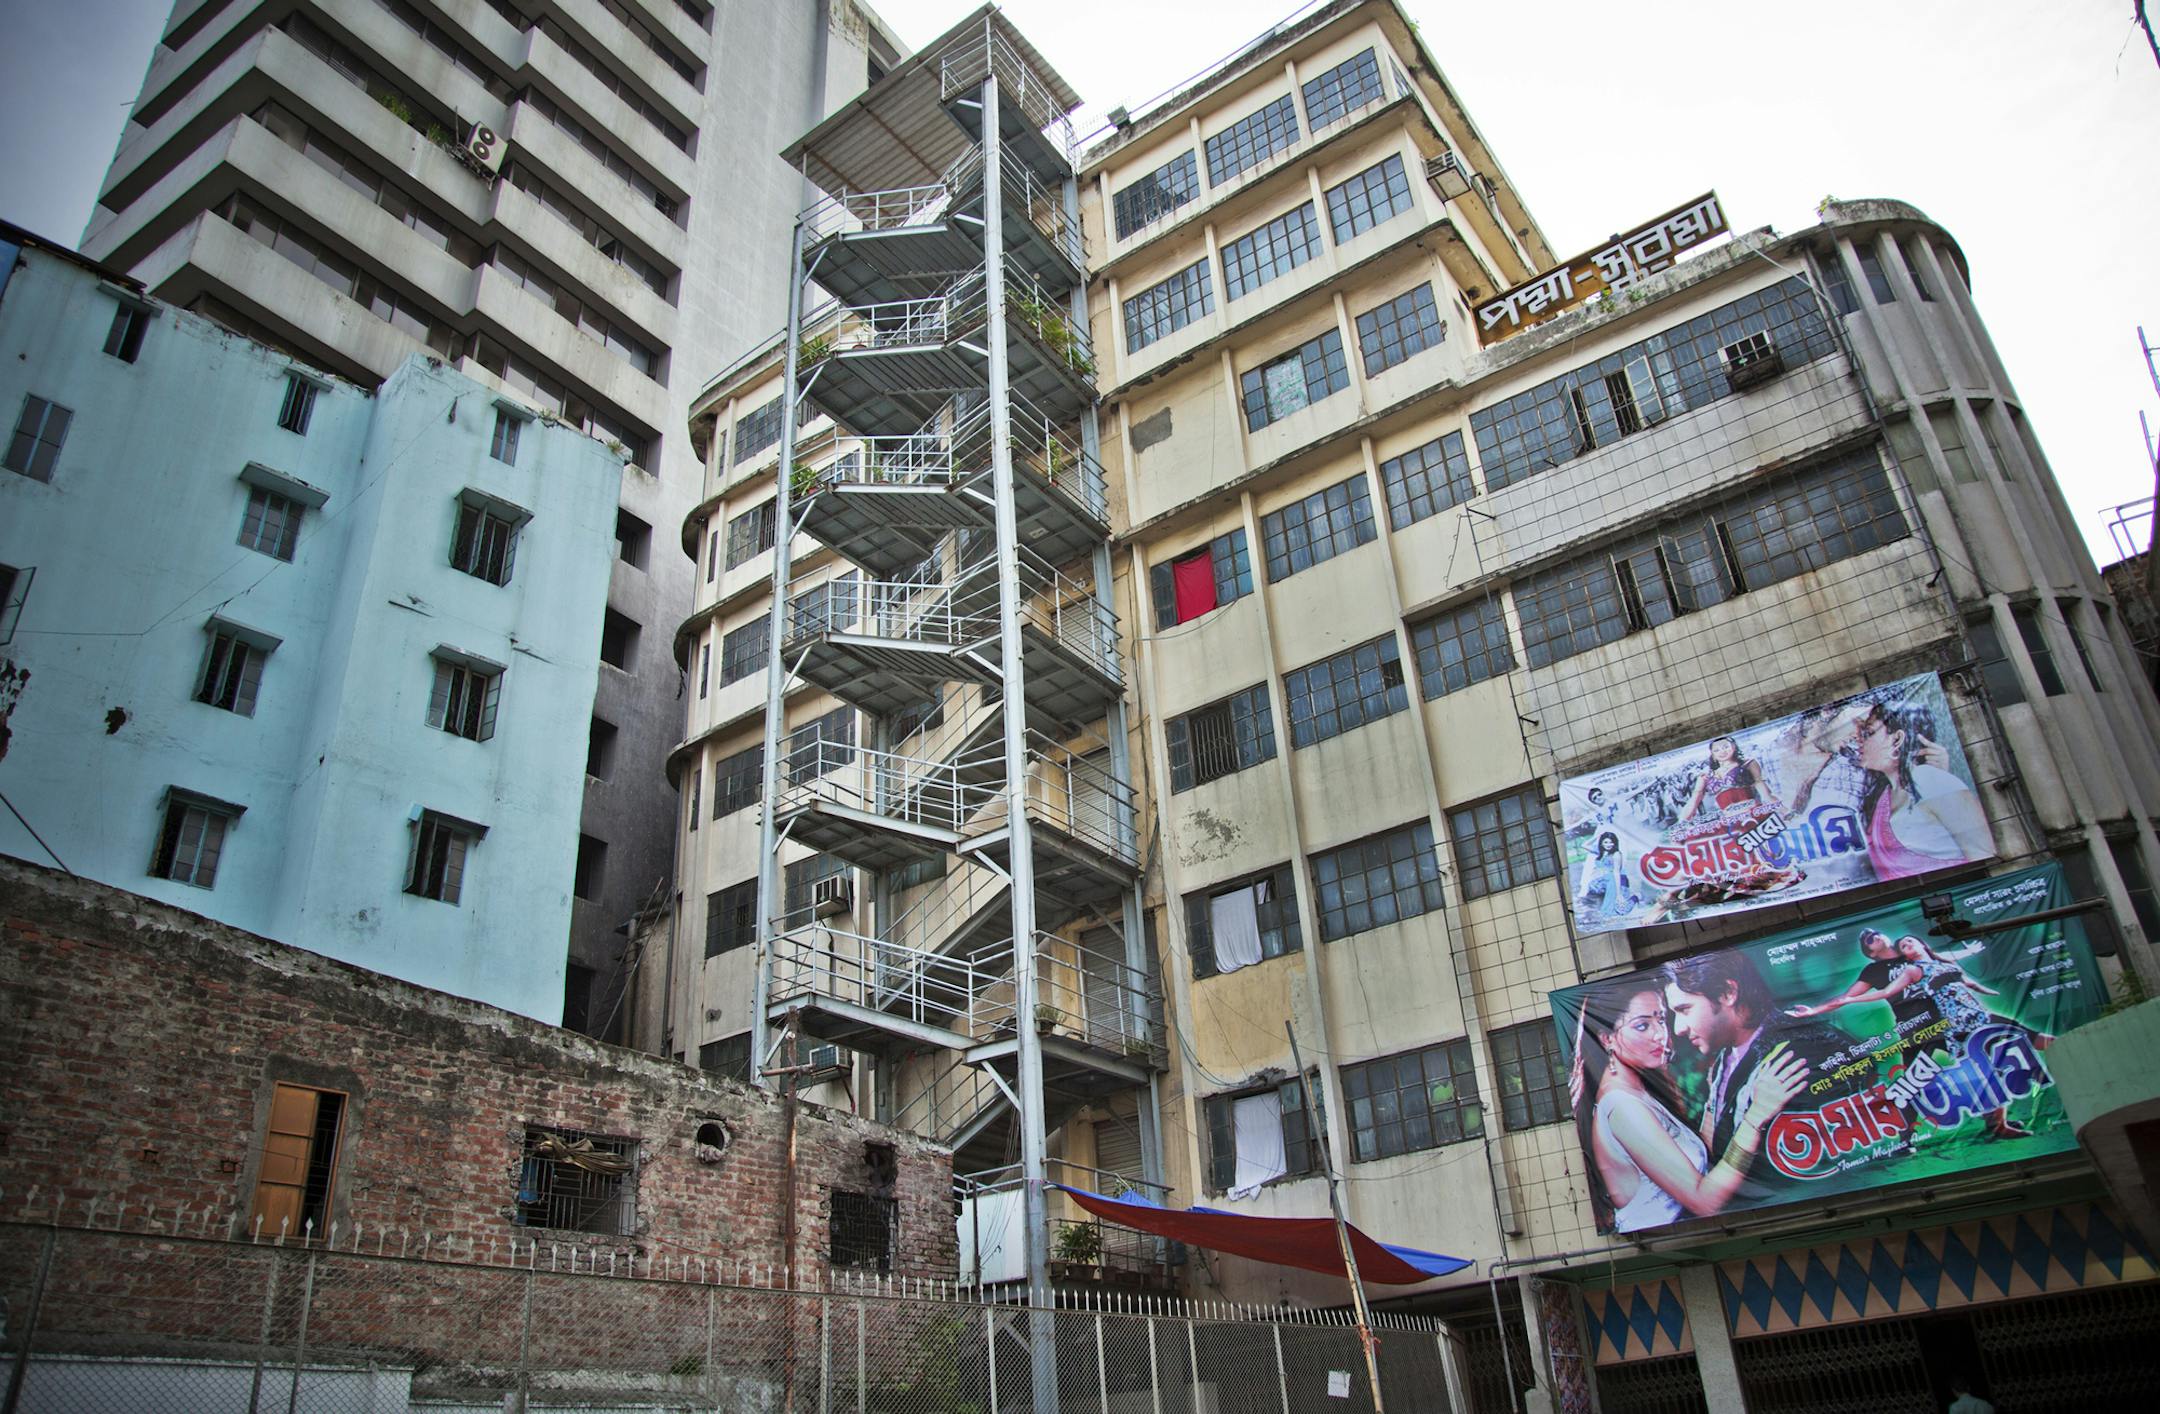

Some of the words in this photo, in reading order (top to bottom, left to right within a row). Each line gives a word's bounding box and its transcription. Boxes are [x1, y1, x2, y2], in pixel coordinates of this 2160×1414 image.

[1736, 811, 1787, 853] মাঝে
[1758, 804, 1867, 870] আমি
[1894, 1010, 1932, 1036] পরিচালনা
[1810, 1078, 1832, 1095] মোঃ
[1832, 1057, 1873, 1082] শফিকুল
[1871, 1038, 1912, 1062] ইসলাম
[1913, 1018, 1953, 1045] সোহেল
[1885, 1049, 1945, 1110] মাঝে
[1910, 1024, 2054, 1130] আমি
[1838, 1156, 1870, 1171] Tomar
